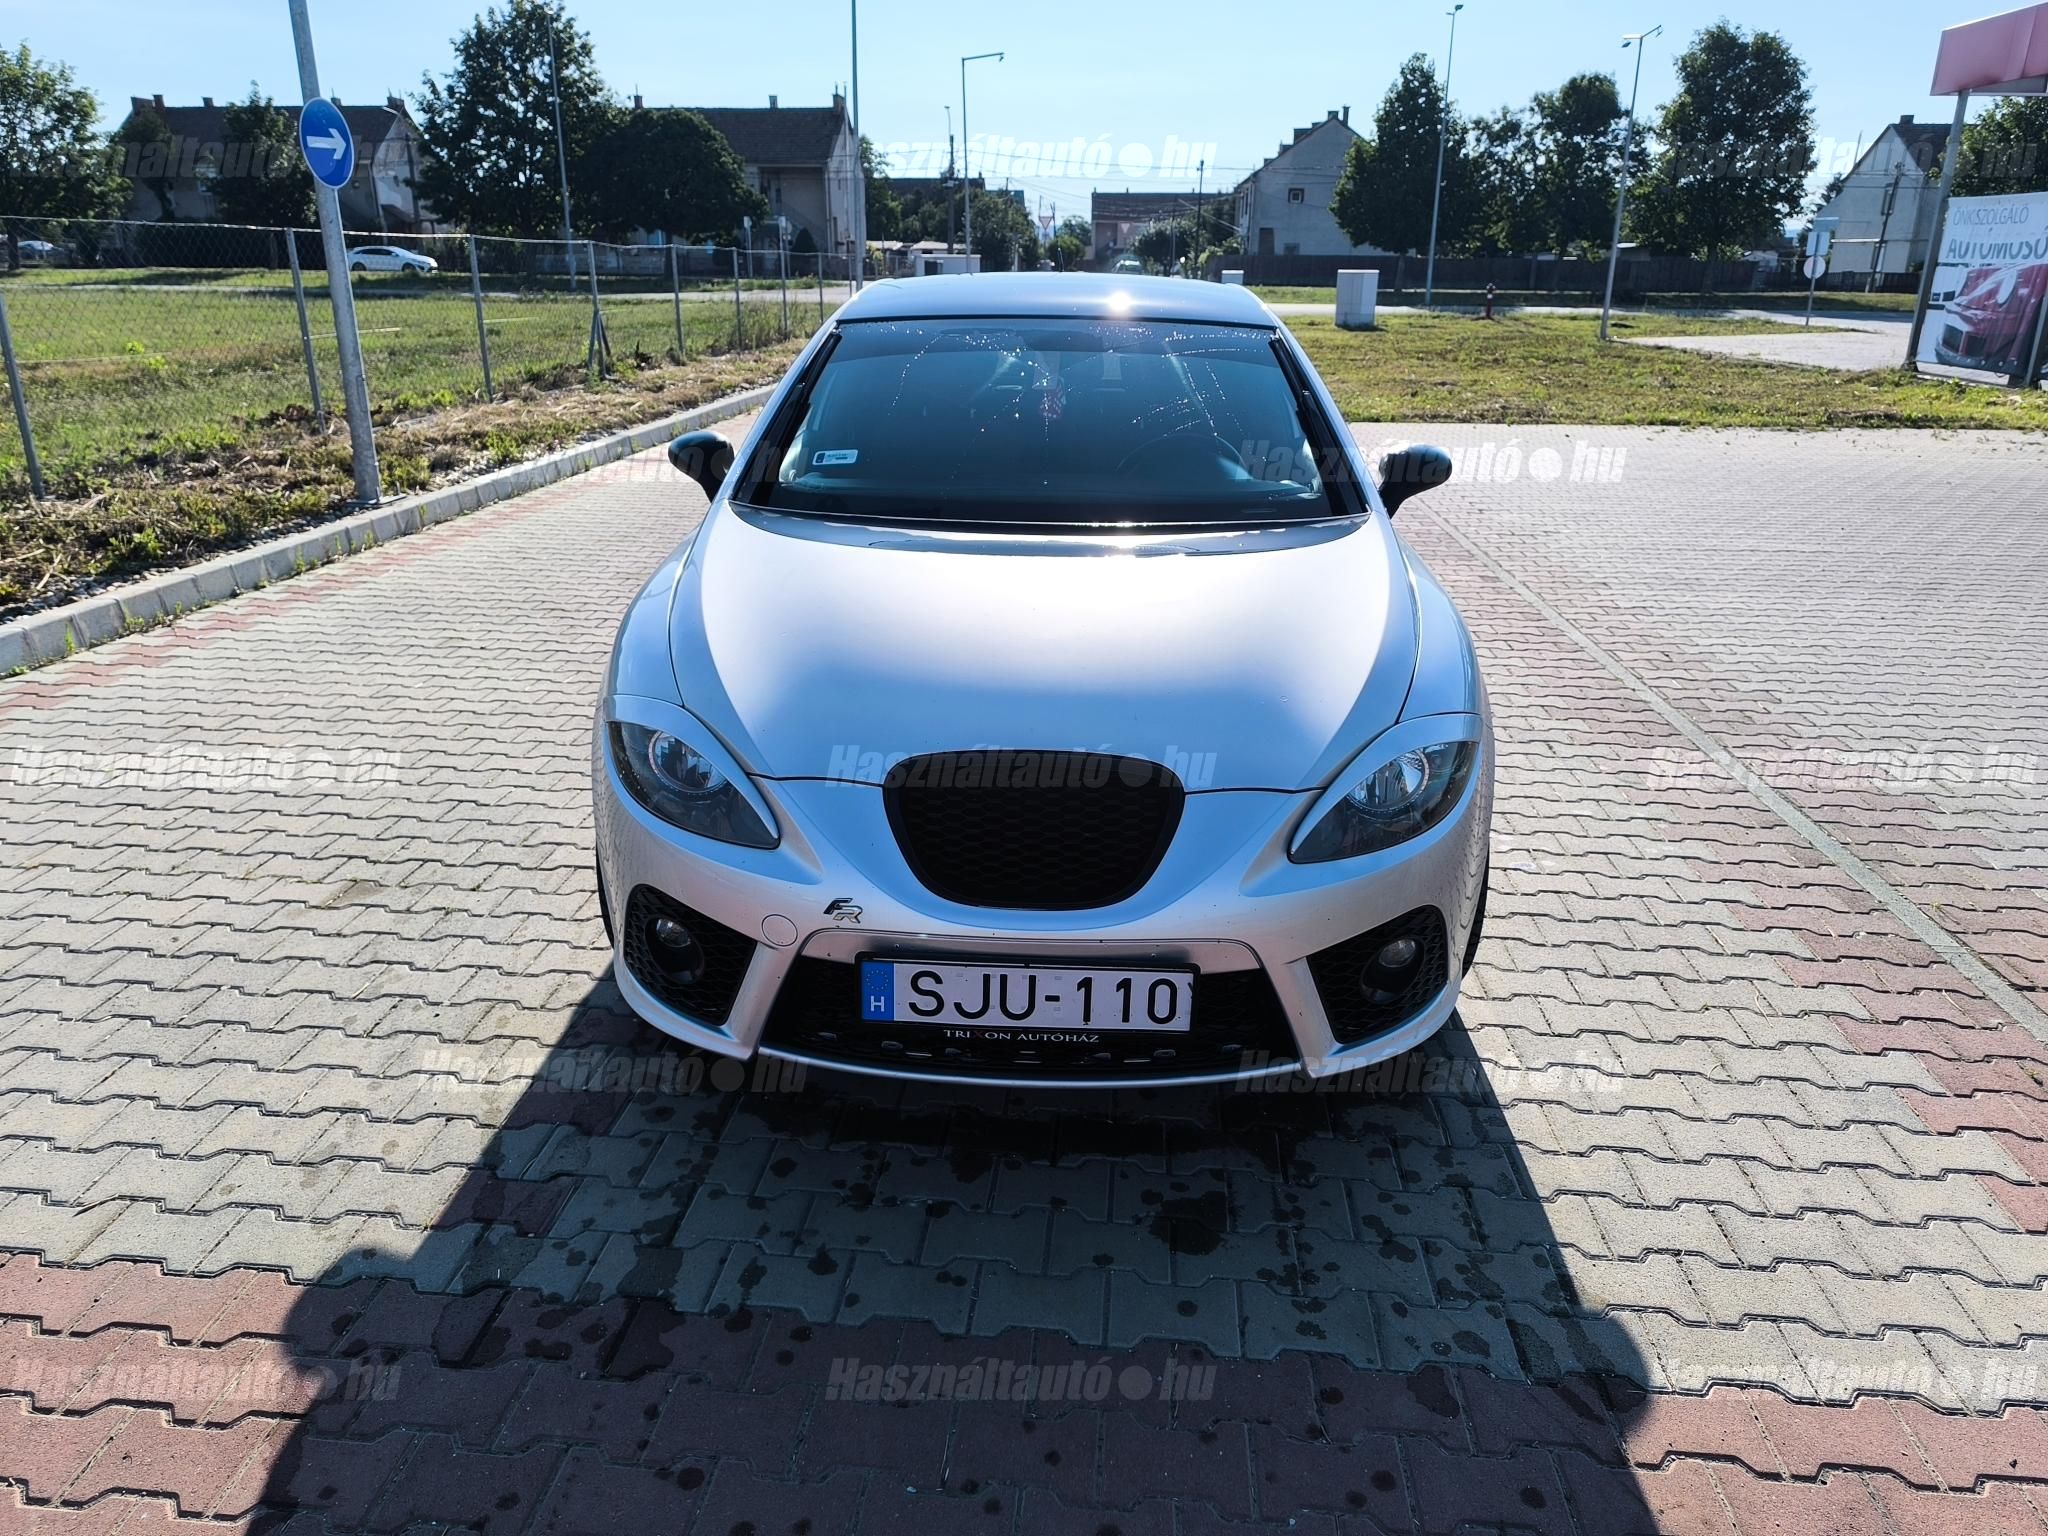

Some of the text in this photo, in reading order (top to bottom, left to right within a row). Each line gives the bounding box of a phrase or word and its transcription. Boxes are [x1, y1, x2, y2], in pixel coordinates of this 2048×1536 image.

[823, 897, 864, 924] FR
[870, 995, 885, 1012] H
[908, 970, 1178, 1025] SJU-110
[1017, 1032, 1099, 1043] AUTÓHÁZ
